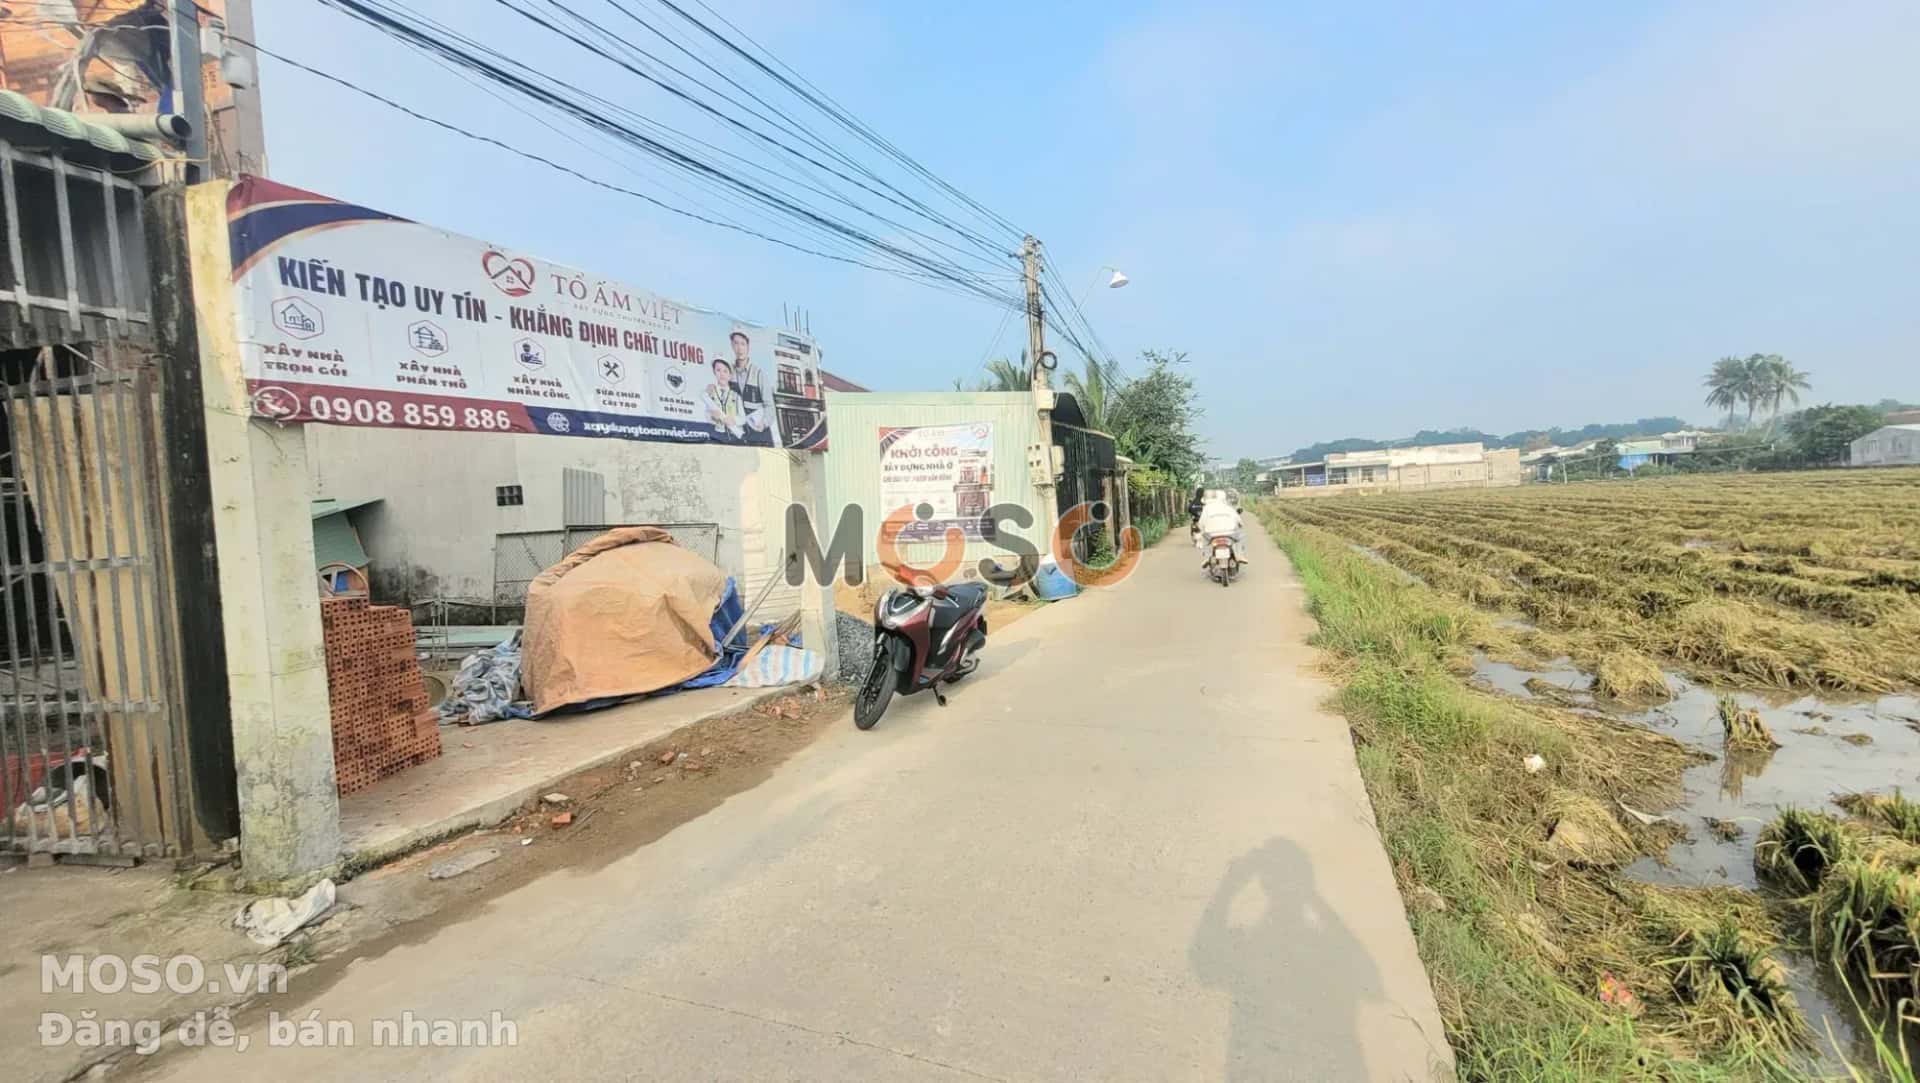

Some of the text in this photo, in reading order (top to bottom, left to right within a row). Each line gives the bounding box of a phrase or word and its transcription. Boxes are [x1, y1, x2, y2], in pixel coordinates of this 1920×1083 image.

[550, 272, 587, 300] TỔ
[594, 281, 631, 311] ẤM
[278, 256, 347, 298] KIẾN
[355, 272, 408, 311] TẠO
[414, 285, 444, 315] UY
[452, 291, 488, 323] TÍN
[510, 304, 573, 338] KHẲNG
[579, 320, 619, 349] ĐỊNH
[623, 330, 659, 356] CHẤT
[663, 339, 705, 366] LƯỢNG
[263, 342, 345, 362] XÂY NHÀ
[263, 361, 348, 377] TRỌN GÓI
[399, 360, 462, 376] XÂY NHÀ
[513, 374, 562, 388] XÂY NHÀ
[507, 386, 571, 400] NHÂN CÔNG
[310, 396, 511, 430] 0908 859 886
[891, 444, 958, 458] KHỞI CÔNG
